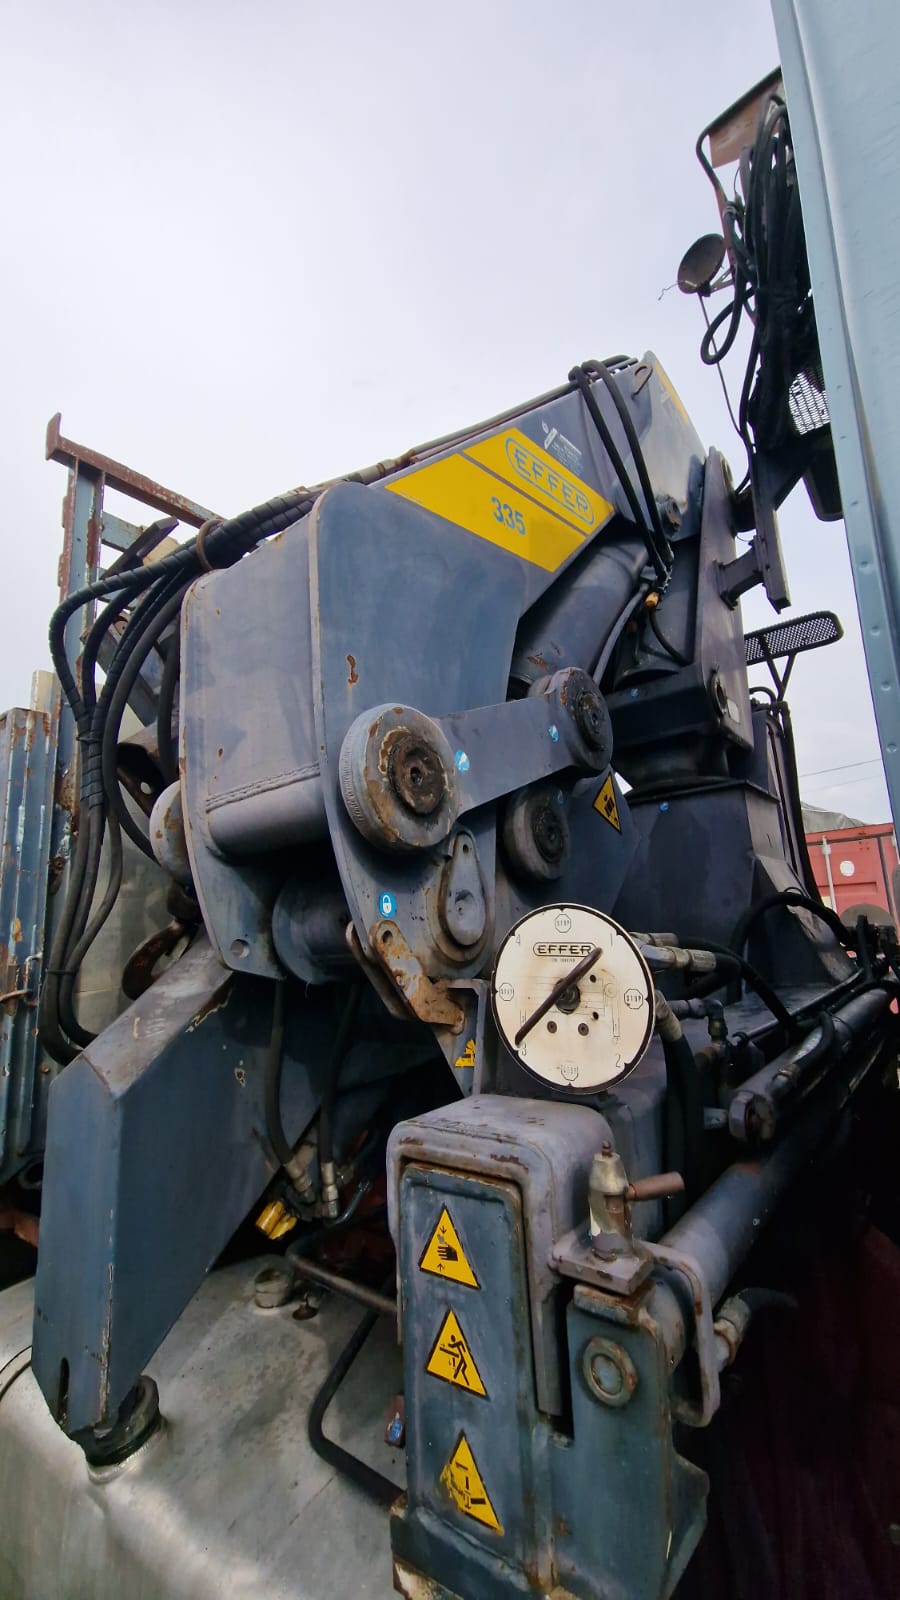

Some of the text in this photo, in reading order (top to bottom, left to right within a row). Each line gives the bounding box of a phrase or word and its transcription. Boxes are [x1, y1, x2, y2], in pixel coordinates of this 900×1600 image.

[513, 448, 590, 517] EFFER
[491, 496, 526, 535] 335
[515, 934, 521, 946] 4
[537, 944, 592, 955] EFFER
[615, 1053, 621, 1067] 2
